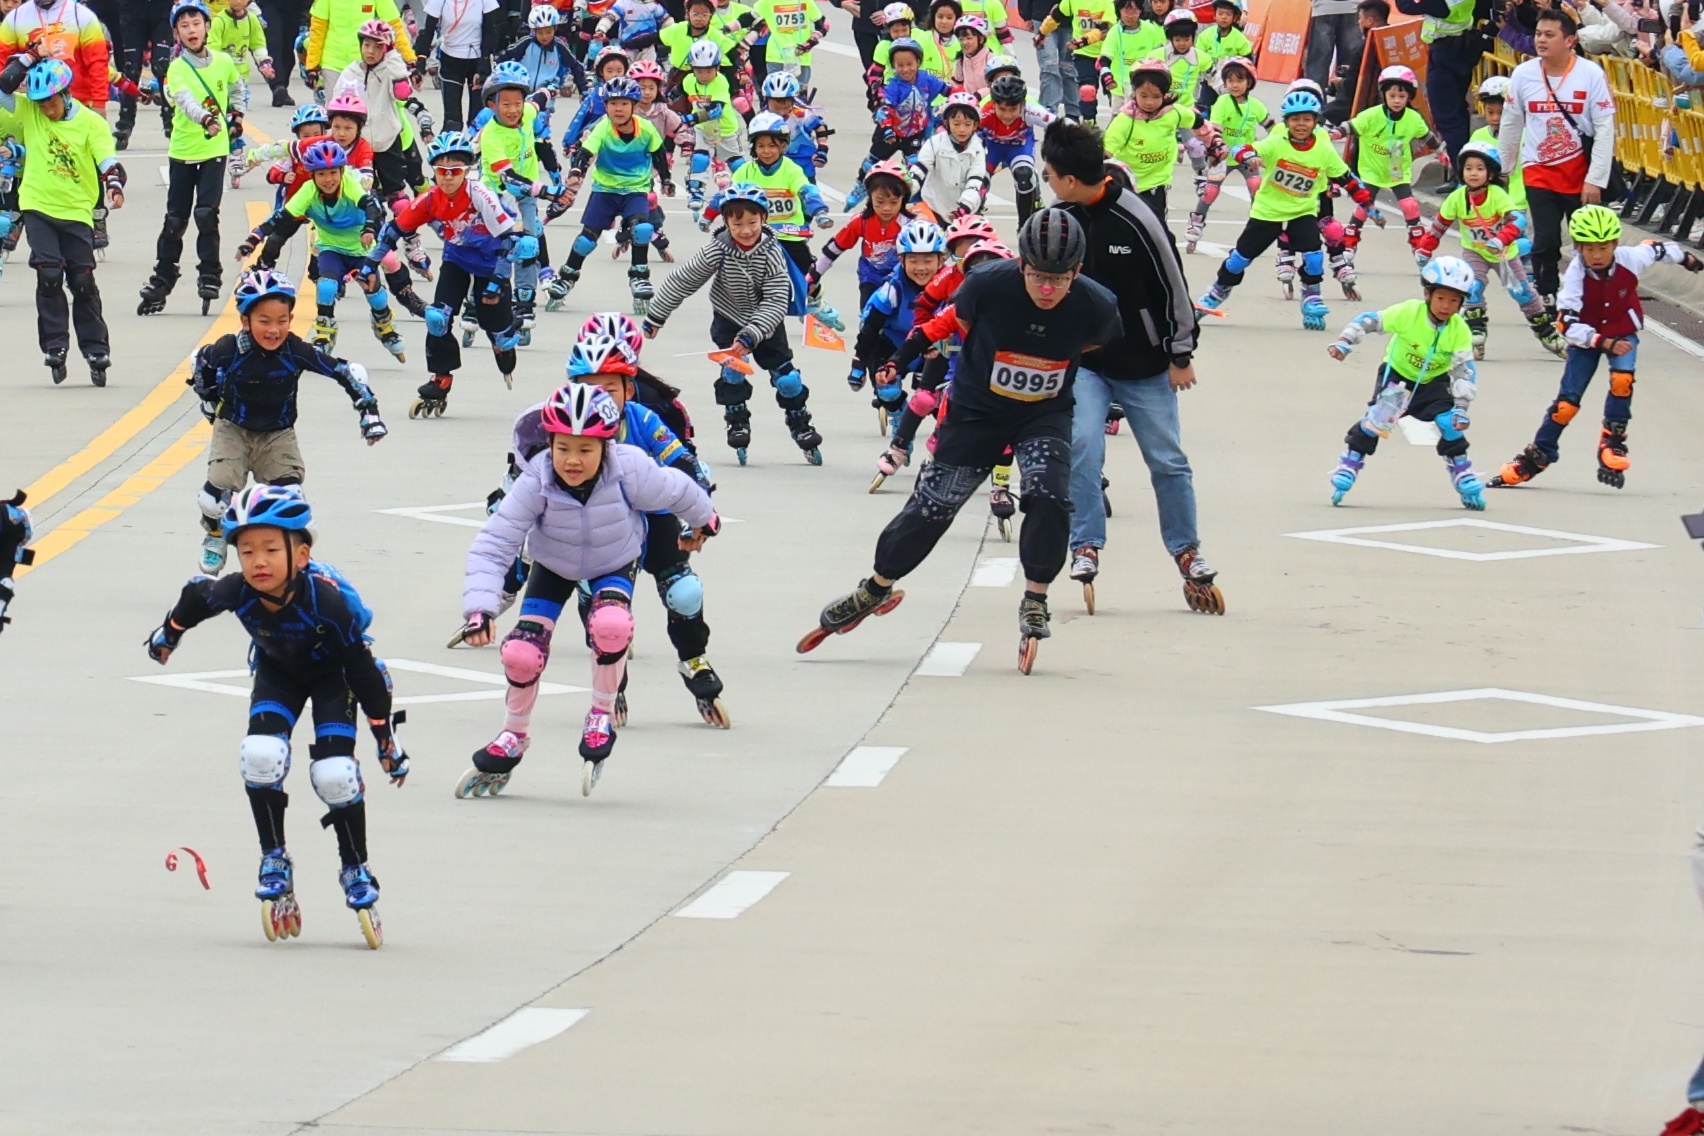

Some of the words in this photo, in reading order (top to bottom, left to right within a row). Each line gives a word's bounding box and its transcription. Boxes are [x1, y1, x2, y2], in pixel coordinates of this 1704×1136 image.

[776, 13, 805, 25] 0759
[1273, 168, 1315, 193] 0729
[473, 184, 498, 212] CHINA
[766, 197, 794, 213] 280
[997, 367, 1059, 391] 0995
